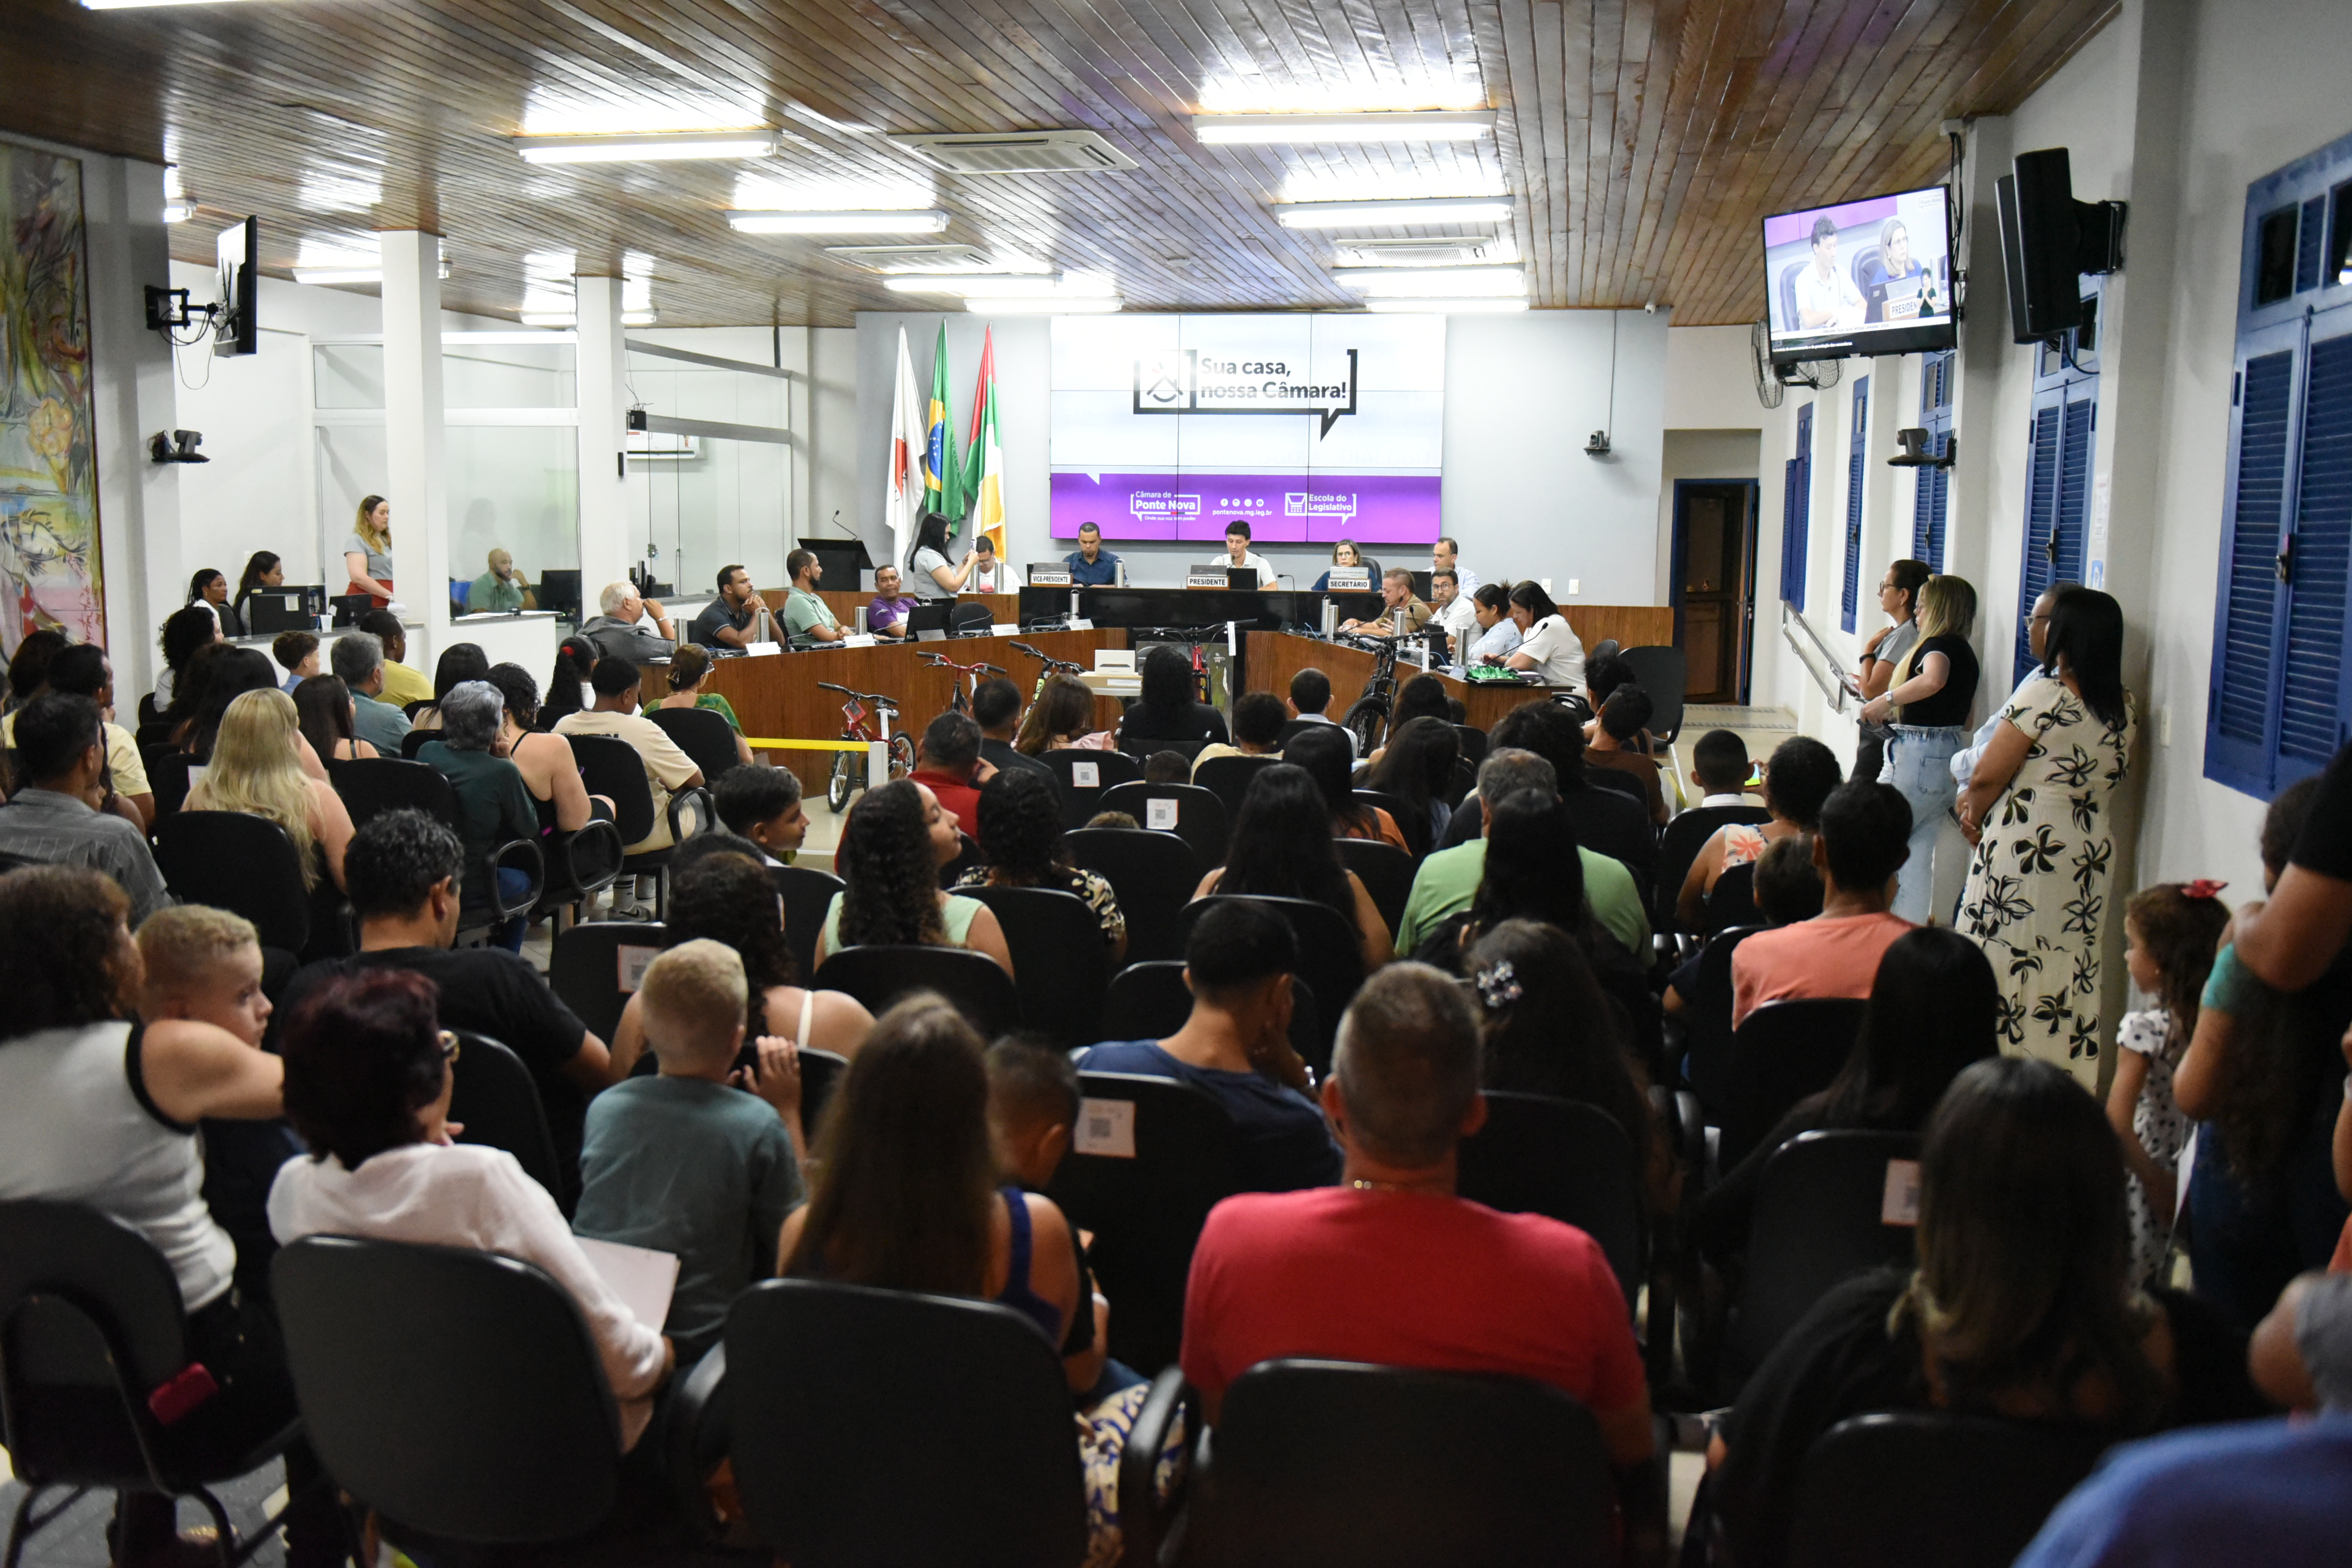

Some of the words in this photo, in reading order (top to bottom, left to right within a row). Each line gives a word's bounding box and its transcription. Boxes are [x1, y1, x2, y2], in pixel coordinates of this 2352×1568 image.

[1201, 358, 1237, 374] Sua
[1242, 362, 1291, 377] casa,
[1200, 385, 1257, 398] nossa
[1262, 381, 1346, 398] Câmara!
[1135, 500, 1166, 509] Ponte
[1168, 500, 1195, 510] Nova
[1308, 503, 1352, 511] Legislativo
